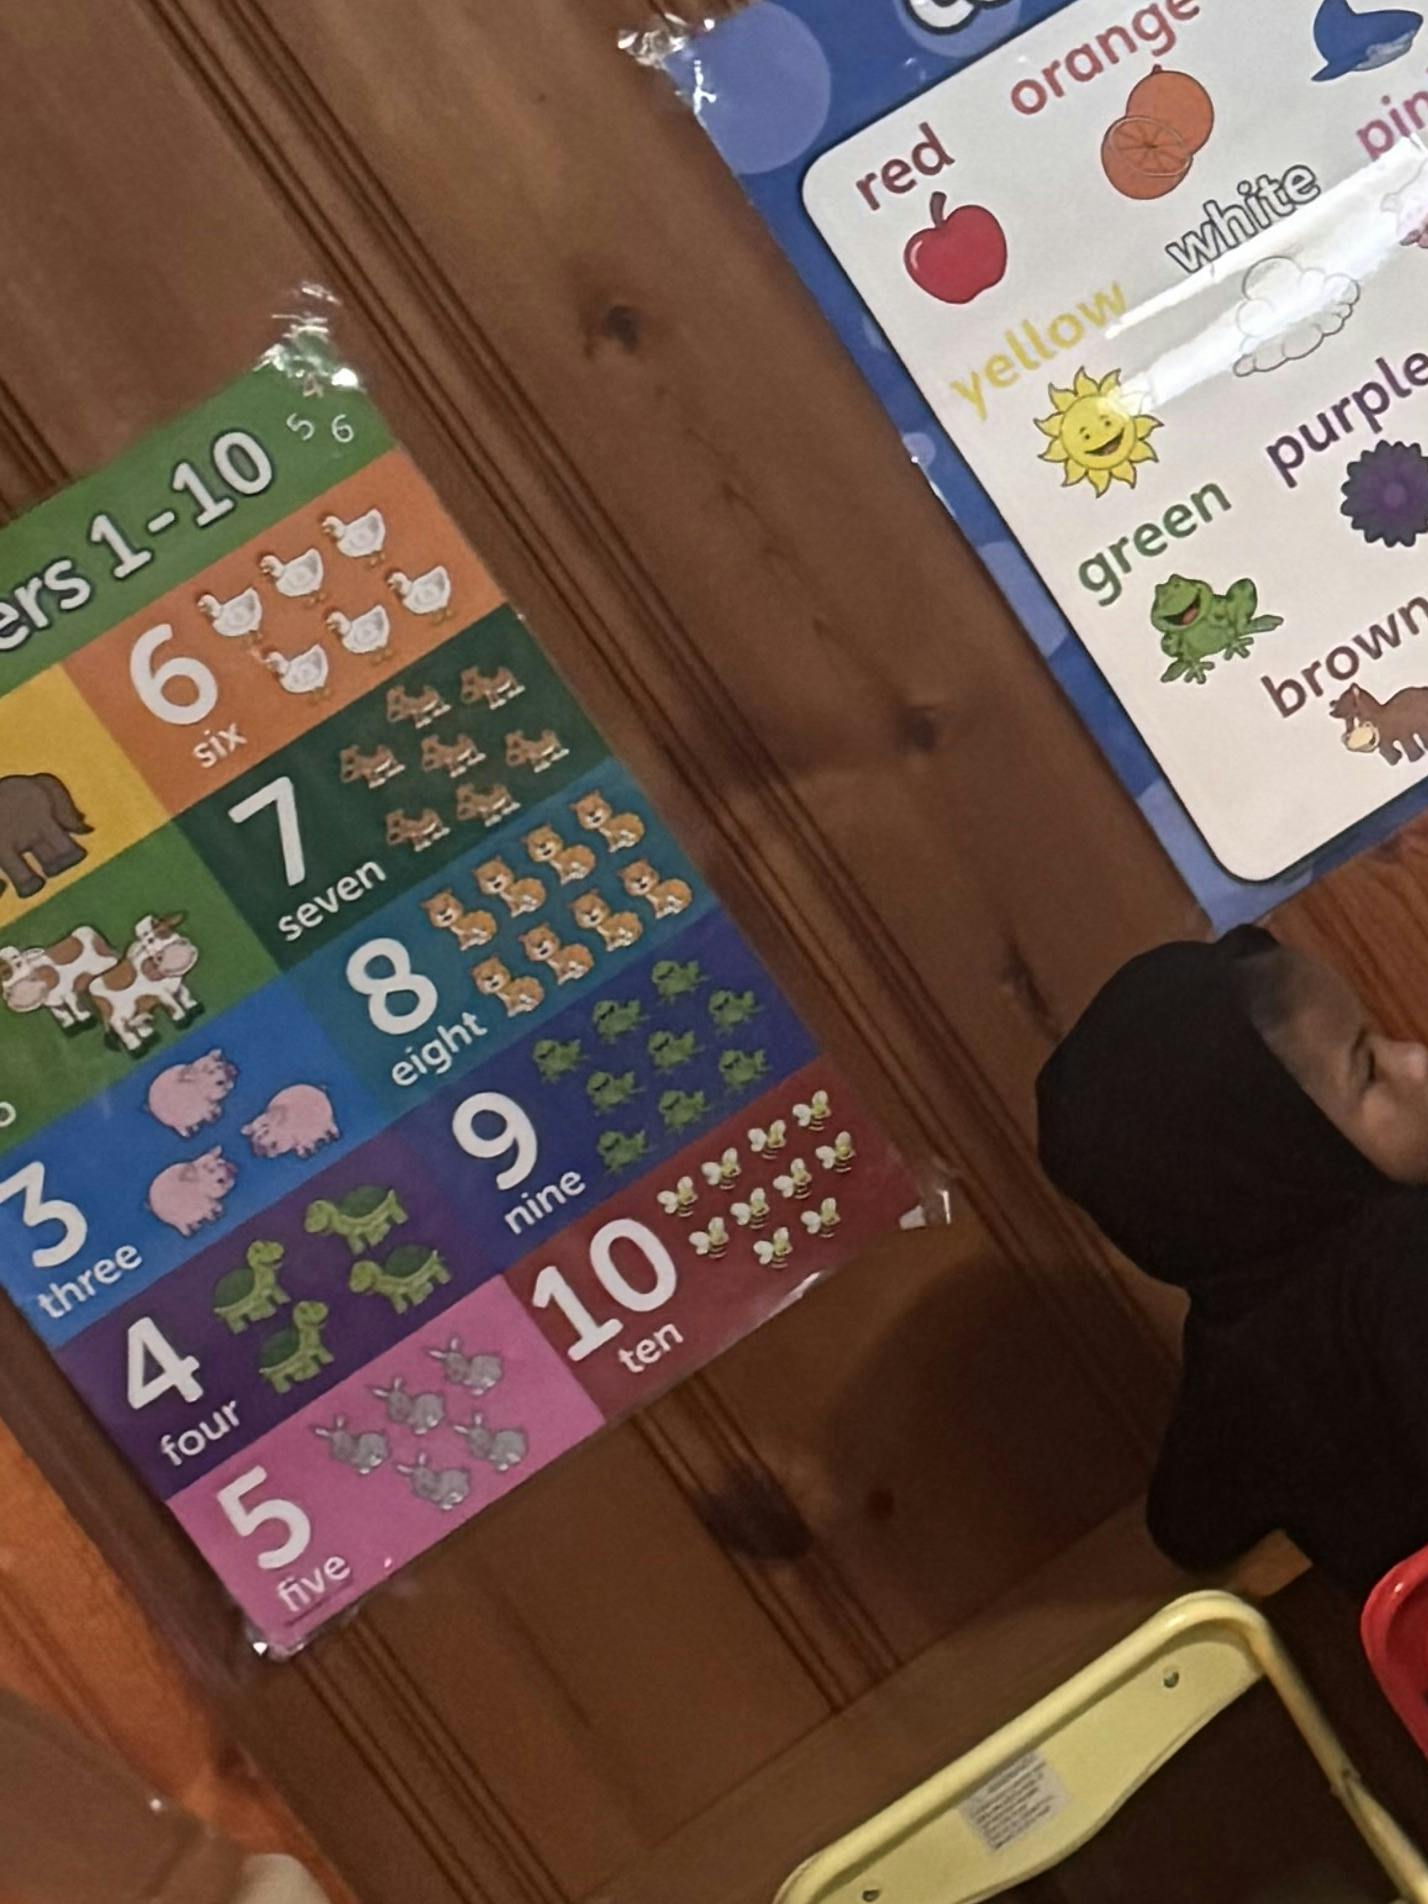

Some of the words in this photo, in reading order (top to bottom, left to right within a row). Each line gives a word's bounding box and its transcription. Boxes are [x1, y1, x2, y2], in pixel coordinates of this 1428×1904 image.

[855, 123, 955, 211] red
[950, 279, 1129, 421] yellow
[1166, 163, 1322, 273] white
[286, 412, 314, 440] 5
[331, 414, 354, 443] 6
[89, 431, 273, 580] 1-10
[1077, 482, 1232, 606] green
[130, 624, 218, 725] 6
[193, 722, 247, 769] six
[229, 776, 306, 887] 7
[277, 860, 386, 942] seven
[347, 937, 439, 1035] 8
[391, 1012, 488, 1088] eight
[452, 1092, 538, 1192] 9
[0, 1161, 88, 1268] 3
[503, 1169, 587, 1235] nine
[36, 1243, 143, 1320] three
[532, 1218, 677, 1363] 10
[126, 1317, 204, 1411] 4
[618, 1323, 684, 1375] ten
[161, 1400, 242, 1467] four
[216, 1466, 311, 1571] 5
[276, 1553, 351, 1613] five
